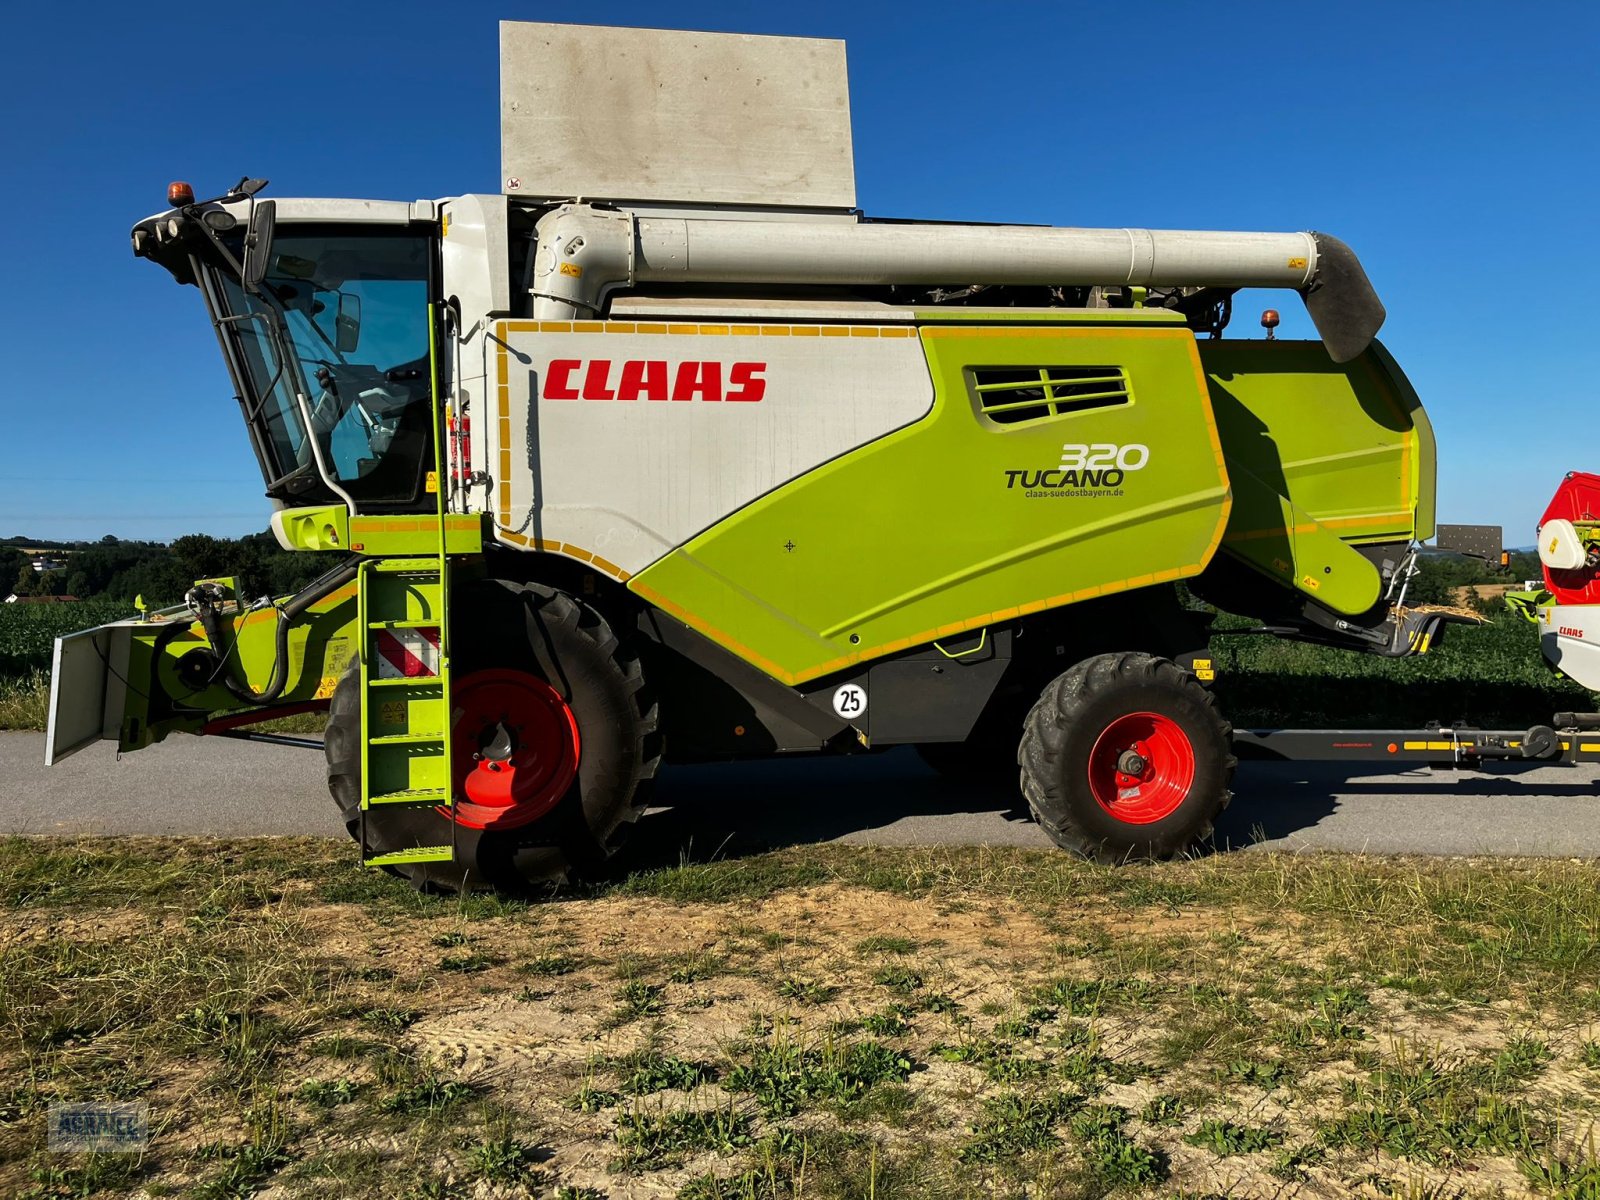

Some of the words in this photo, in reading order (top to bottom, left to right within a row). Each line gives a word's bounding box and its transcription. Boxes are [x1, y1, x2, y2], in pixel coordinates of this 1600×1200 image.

[543, 359, 767, 402] CLAAS
[1058, 443, 1150, 471] 320
[1004, 468, 1124, 489] TUCANO
[1025, 487, 1124, 498] claas-suedostbayern.de
[1559, 626, 1583, 638] CLAAS
[840, 690, 860, 712] 25
